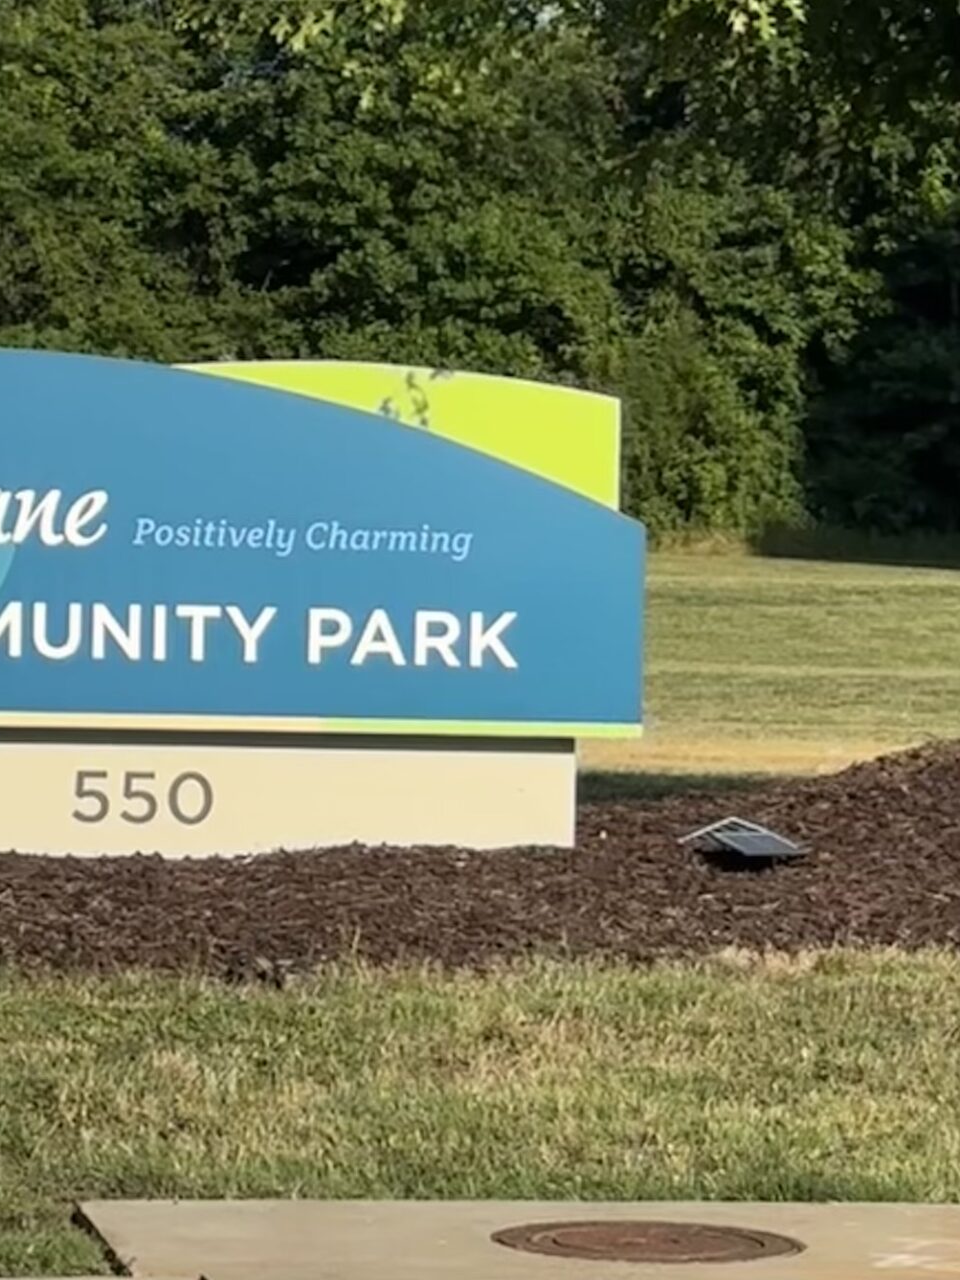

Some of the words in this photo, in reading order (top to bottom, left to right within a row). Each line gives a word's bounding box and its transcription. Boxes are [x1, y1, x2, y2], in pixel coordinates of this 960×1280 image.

[132, 517, 296, 557] Positively
[305, 521, 473, 562] Charming
[307, 607, 519, 669] PARK
[72, 770, 214, 826] 550
